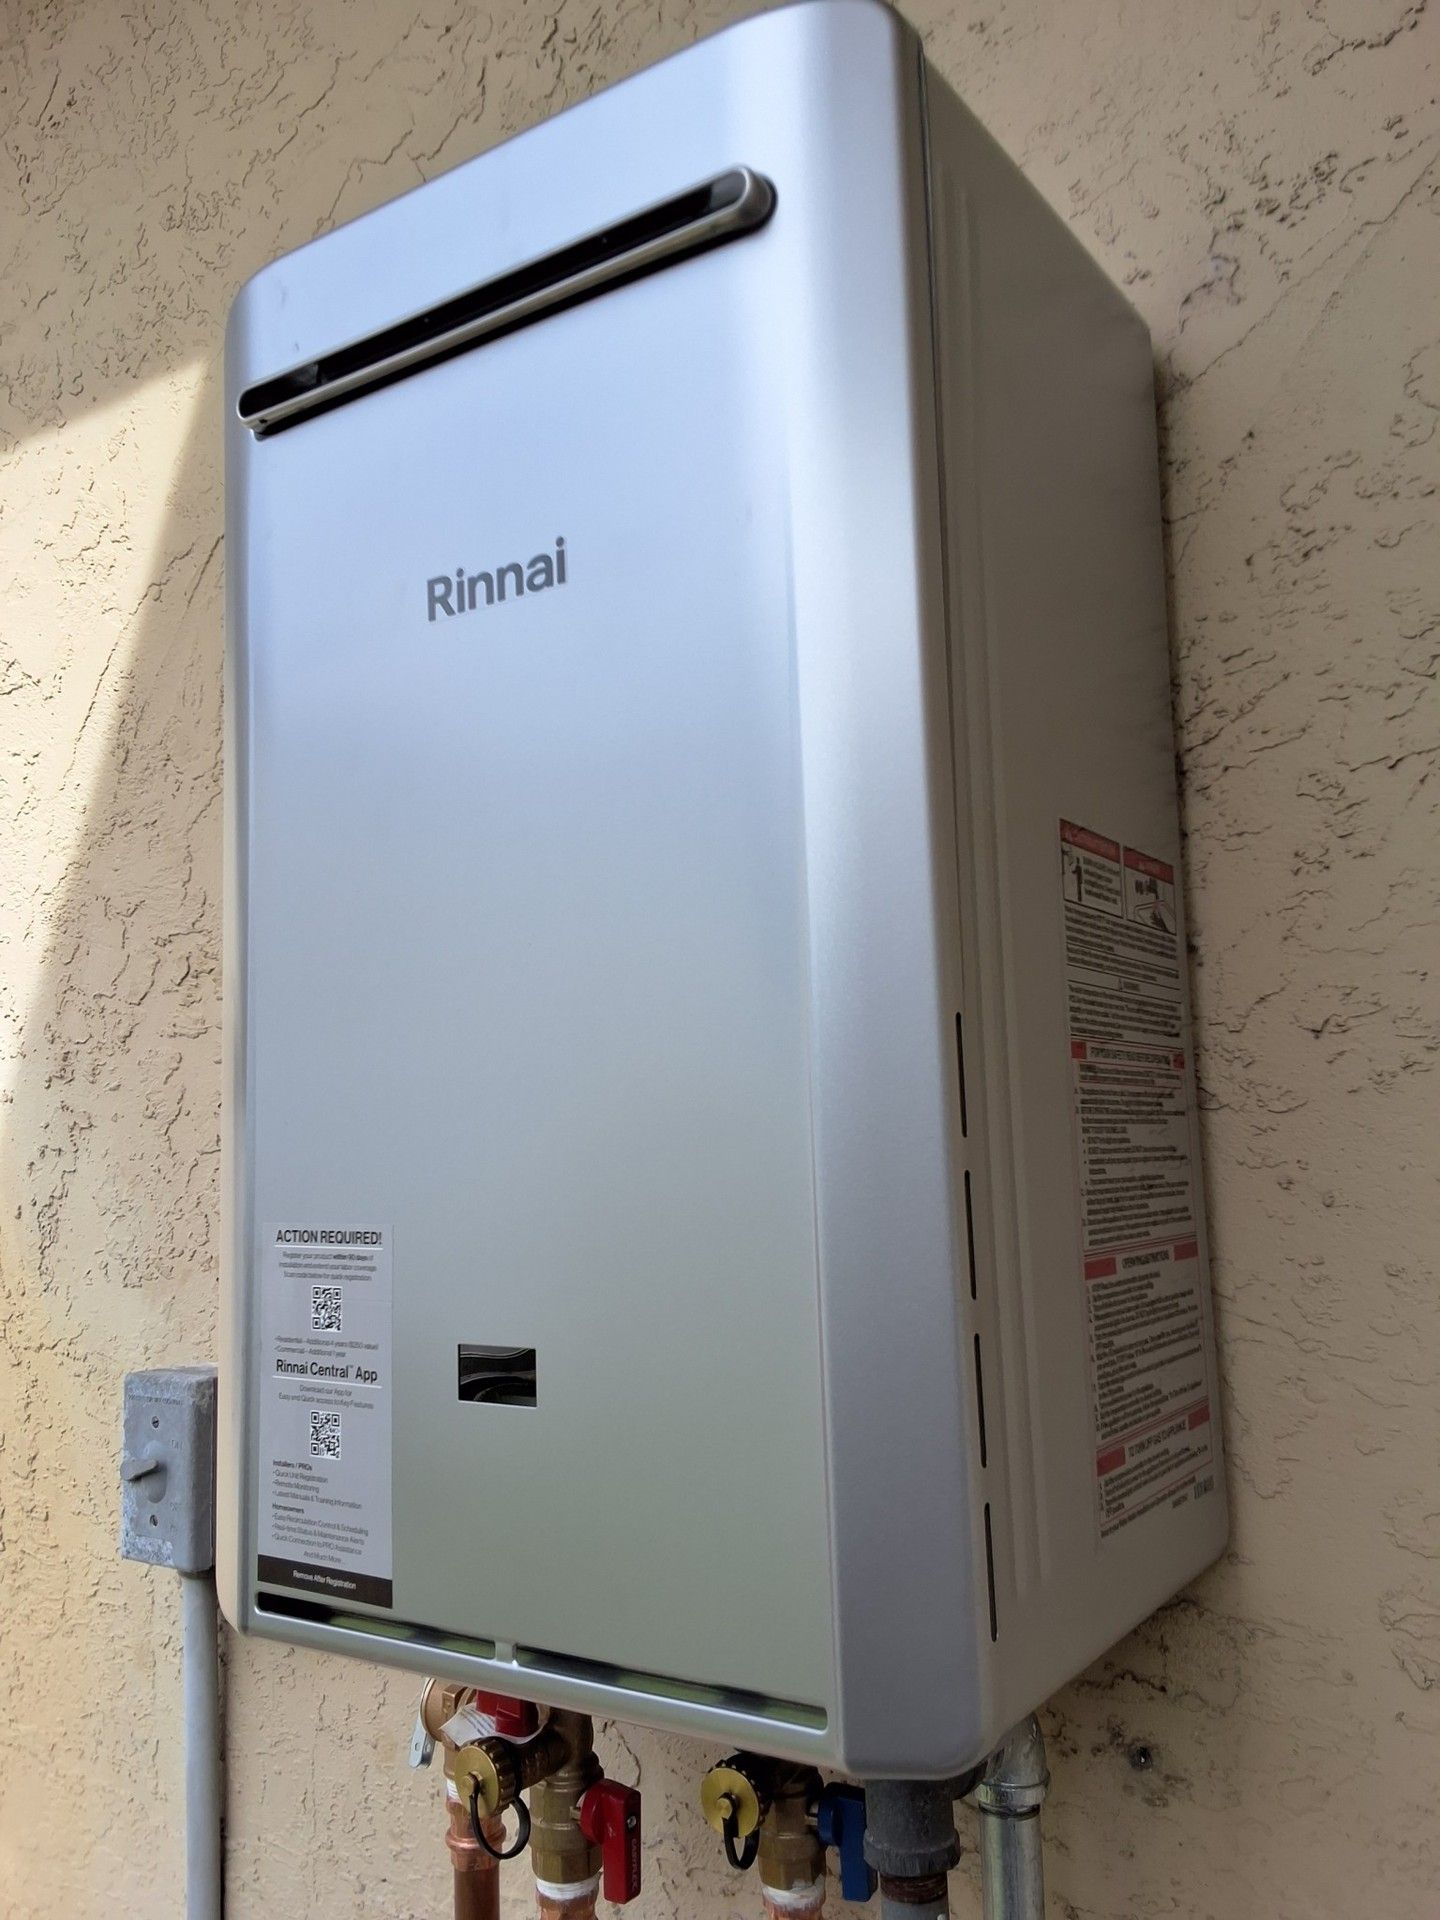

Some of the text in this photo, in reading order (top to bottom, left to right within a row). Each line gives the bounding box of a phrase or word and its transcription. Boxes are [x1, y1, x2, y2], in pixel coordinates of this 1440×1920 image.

[427, 536, 566, 622] Rinnai
[276, 1230, 382, 1245] ACTION REQUIRED!
[276, 1359, 307, 1374] Rinnai
[355, 1366, 377, 1383] App
